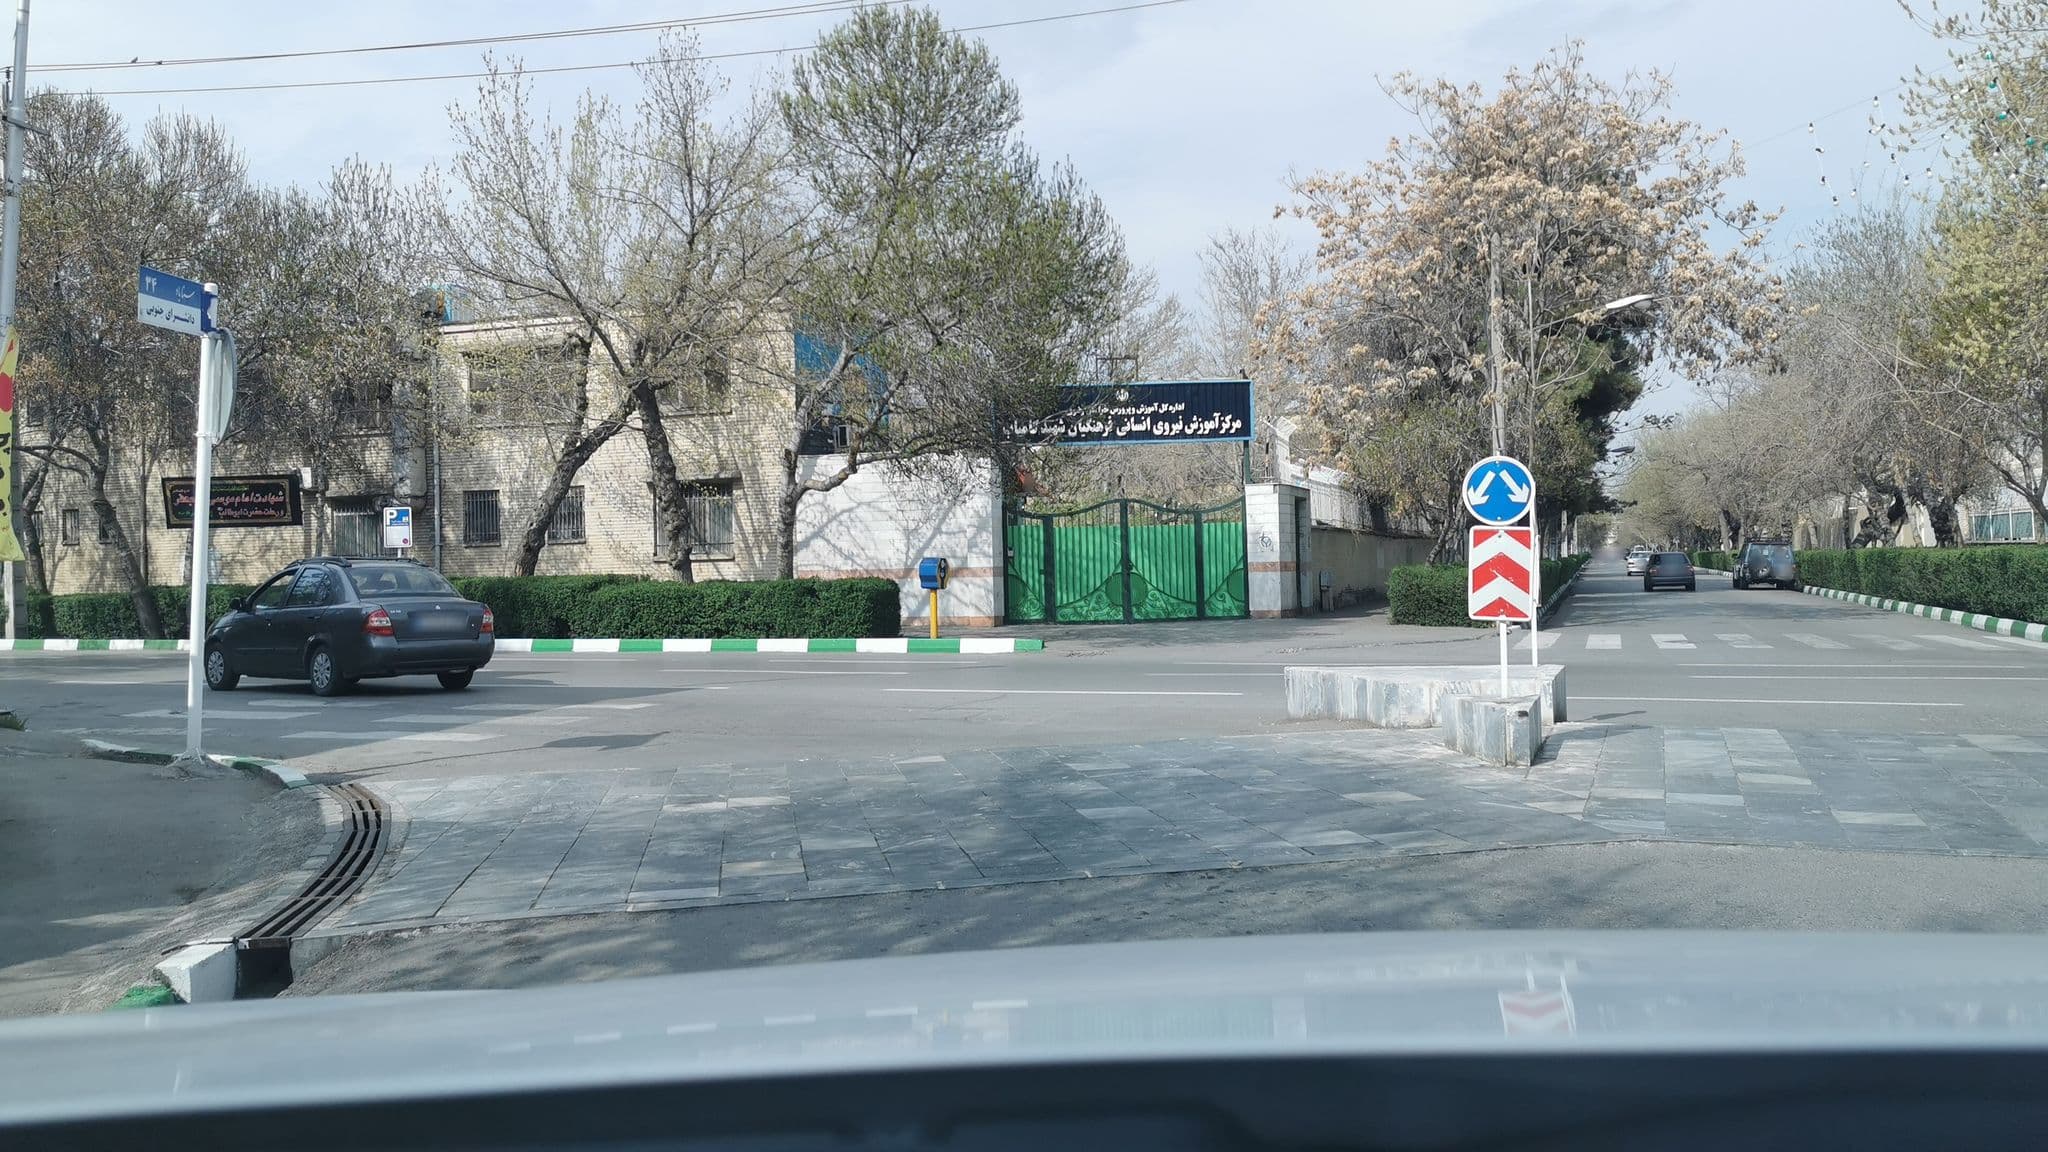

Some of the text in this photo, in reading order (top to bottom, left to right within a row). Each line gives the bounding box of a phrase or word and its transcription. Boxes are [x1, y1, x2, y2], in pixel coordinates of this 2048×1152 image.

[145, 275, 158, 293] ۳۴
[146, 304, 195, 325] دانشسرای جنوبی
[1136, 402, 1158, 415] آموزش
[1158, 402, 1169, 413] کل
[1169, 402, 1185, 414] اداره
[1040, 418, 1066, 435] شهید
[1067, 415, 1113, 438] فرهنگیان
[1116, 416, 1151, 437] انسانی
[1152, 415, 1184, 436] نیروی
[1184, 412, 1221, 435] آموزش
[1219, 413, 1242, 434] مرکز
[234, 492, 254, 507] امام
[254, 490, 285, 505] شهادت
[386, 509, 398, 526] P
